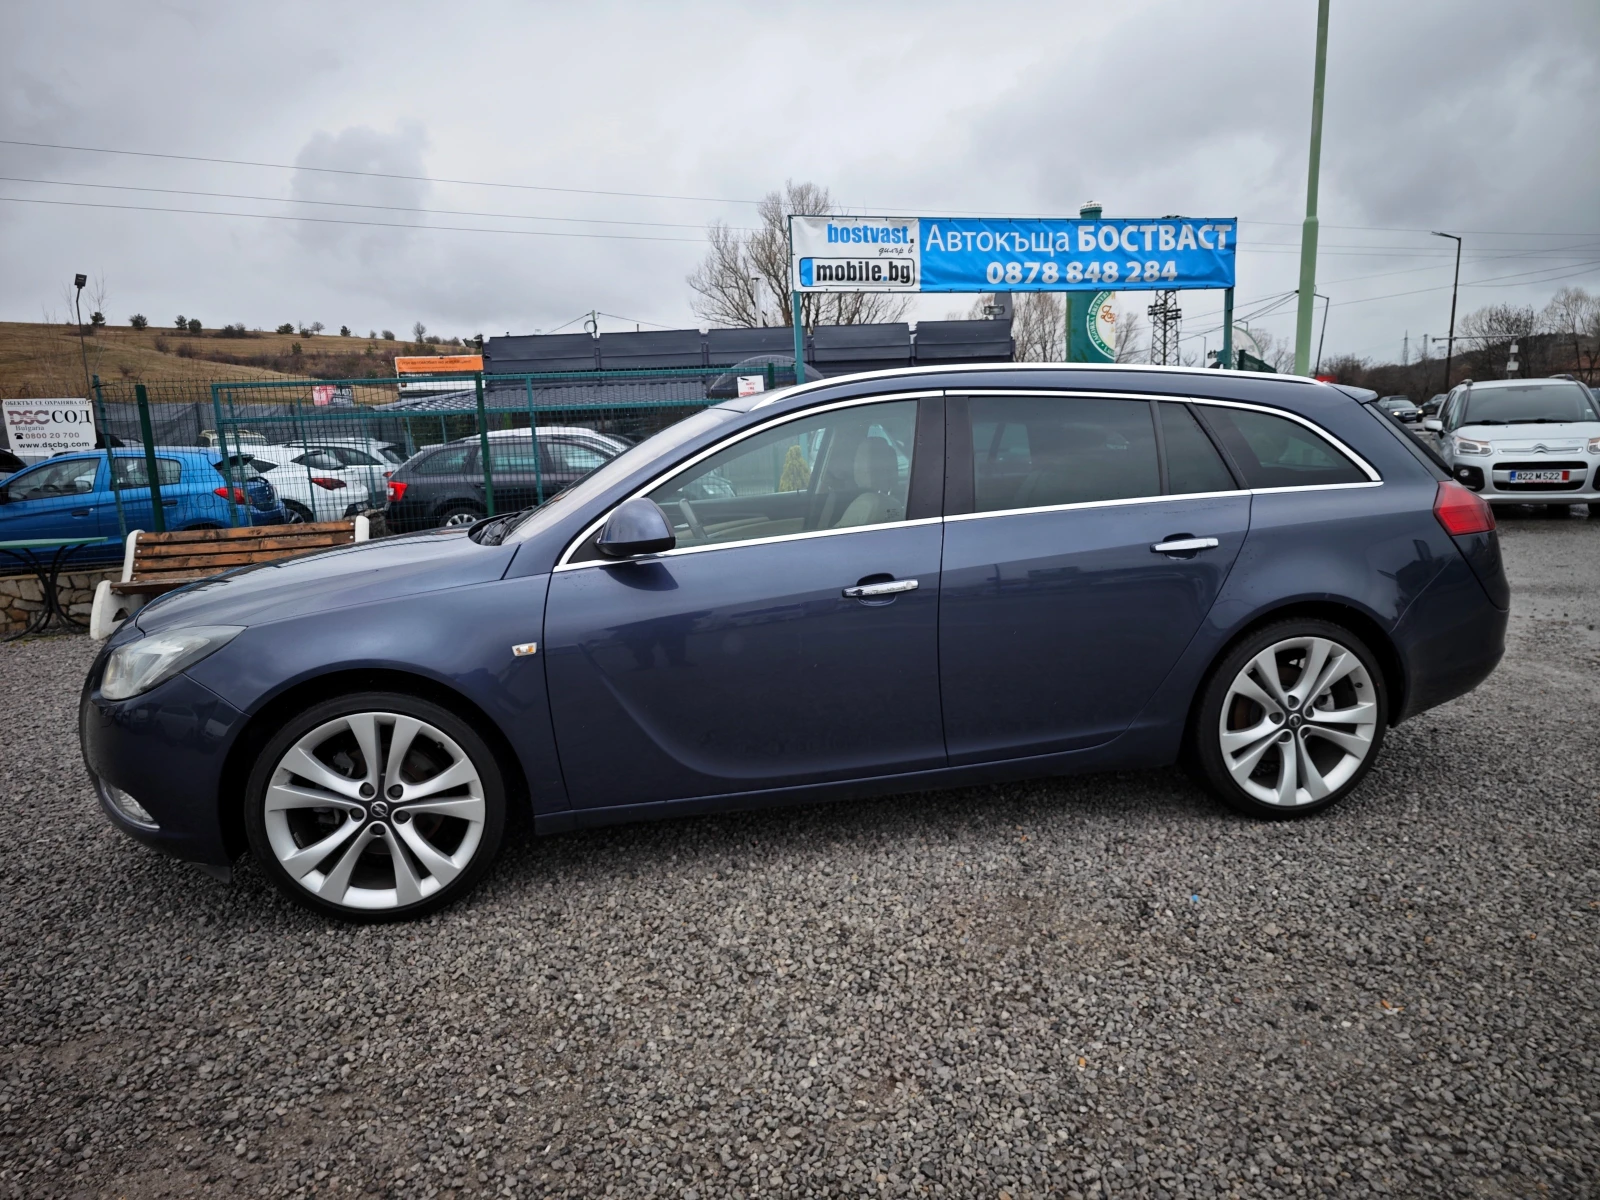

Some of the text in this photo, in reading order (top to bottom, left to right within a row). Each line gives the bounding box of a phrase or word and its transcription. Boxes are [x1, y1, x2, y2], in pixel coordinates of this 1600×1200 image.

[925, 224, 1232, 257] Автокъща БОСТВАСТ
[816, 261, 911, 284] mobile.bg
[986, 260, 1178, 284] 0878 848 284
[7, 409, 51, 425] DSC
[52, 409, 92, 426] СОД
[25, 432, 47, 440] 0800
[18, 441, 90, 449] www.dscbg.com
[1516, 472, 1534, 480] 822
[1543, 472, 1560, 480] 522
